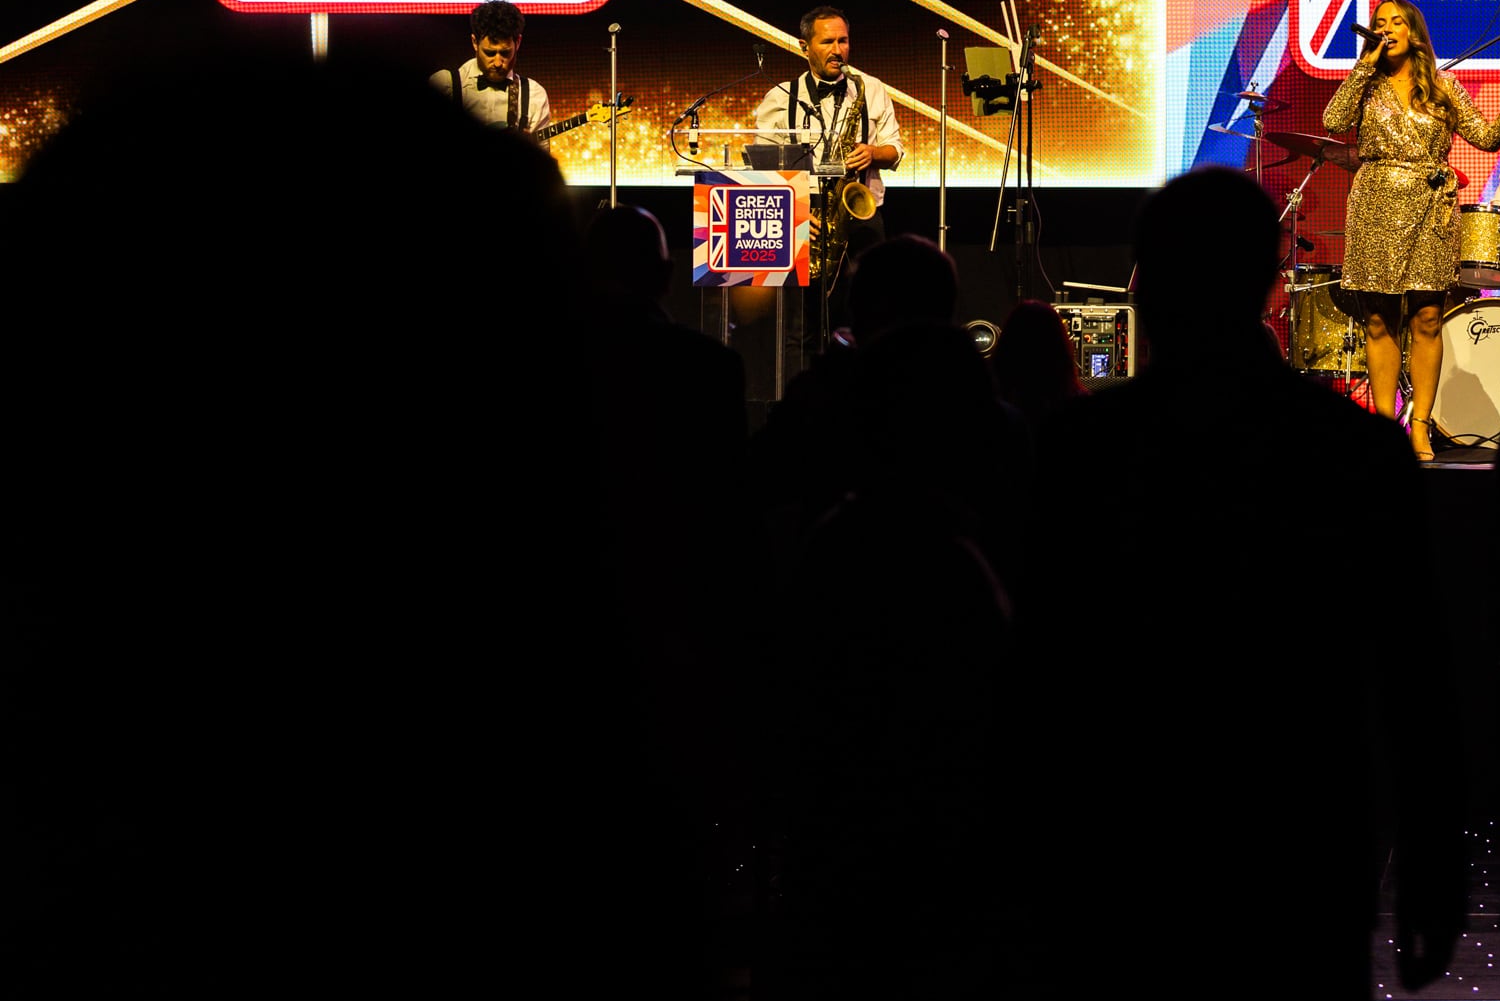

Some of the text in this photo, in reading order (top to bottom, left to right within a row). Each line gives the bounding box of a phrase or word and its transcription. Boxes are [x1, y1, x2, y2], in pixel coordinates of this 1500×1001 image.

[735, 195, 784, 208] GREAT
[735, 209, 784, 220] BRITISH
[735, 220, 783, 239] PUB
[735, 239, 783, 249] AWARDS
[740, 250, 777, 262] 2025
